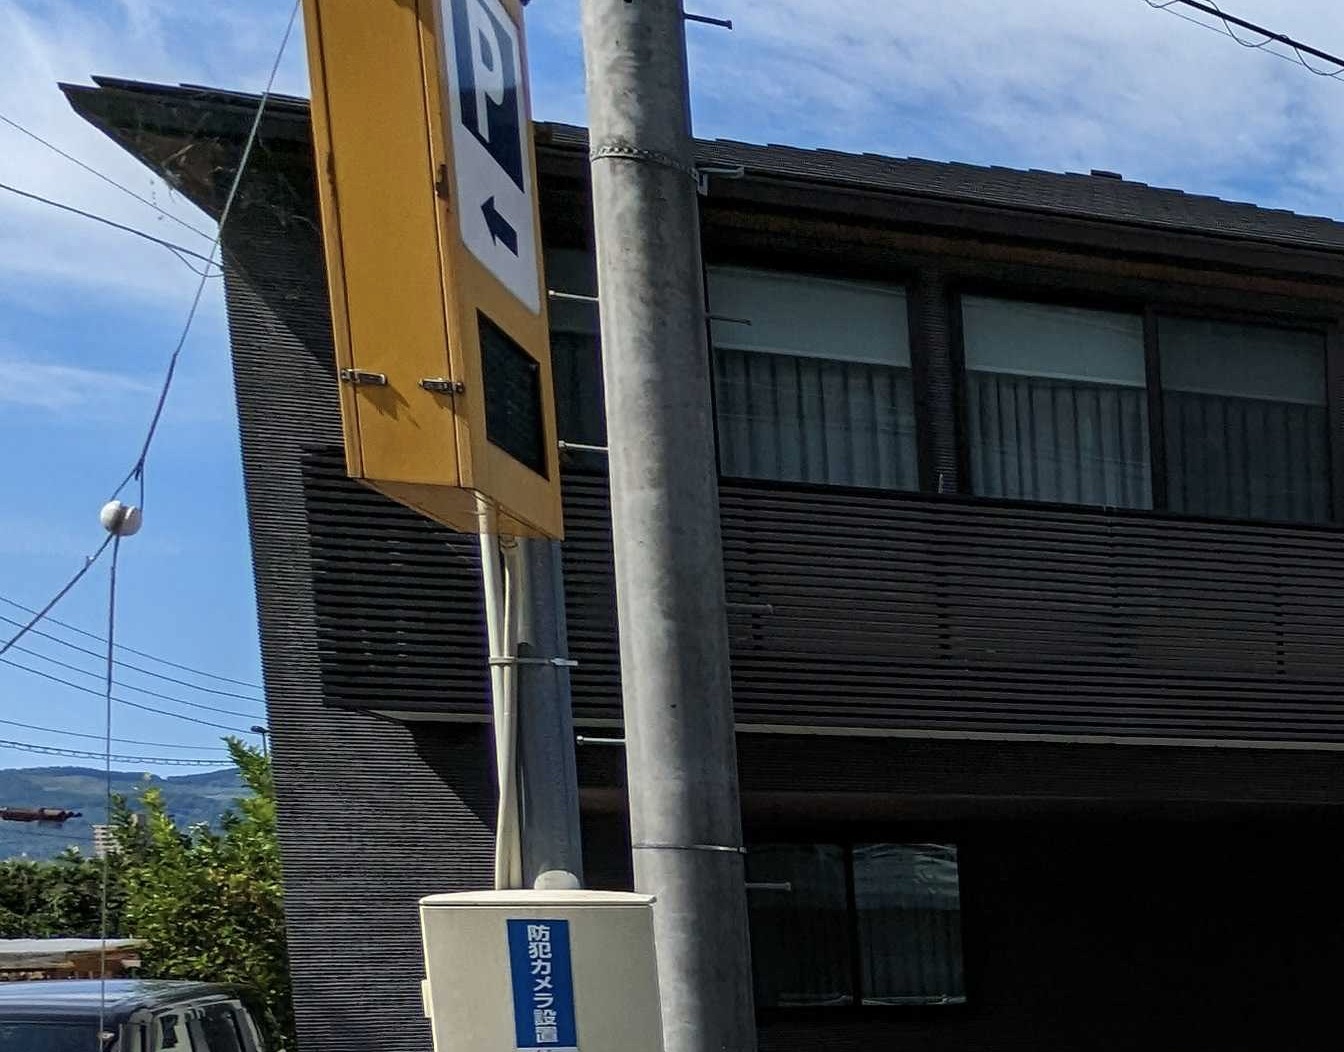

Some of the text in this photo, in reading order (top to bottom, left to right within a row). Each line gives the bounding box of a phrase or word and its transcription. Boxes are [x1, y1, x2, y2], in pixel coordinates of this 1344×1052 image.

[467, 0, 504, 143] P
[527, 924, 559, 1043] 防犯カメラ設置
